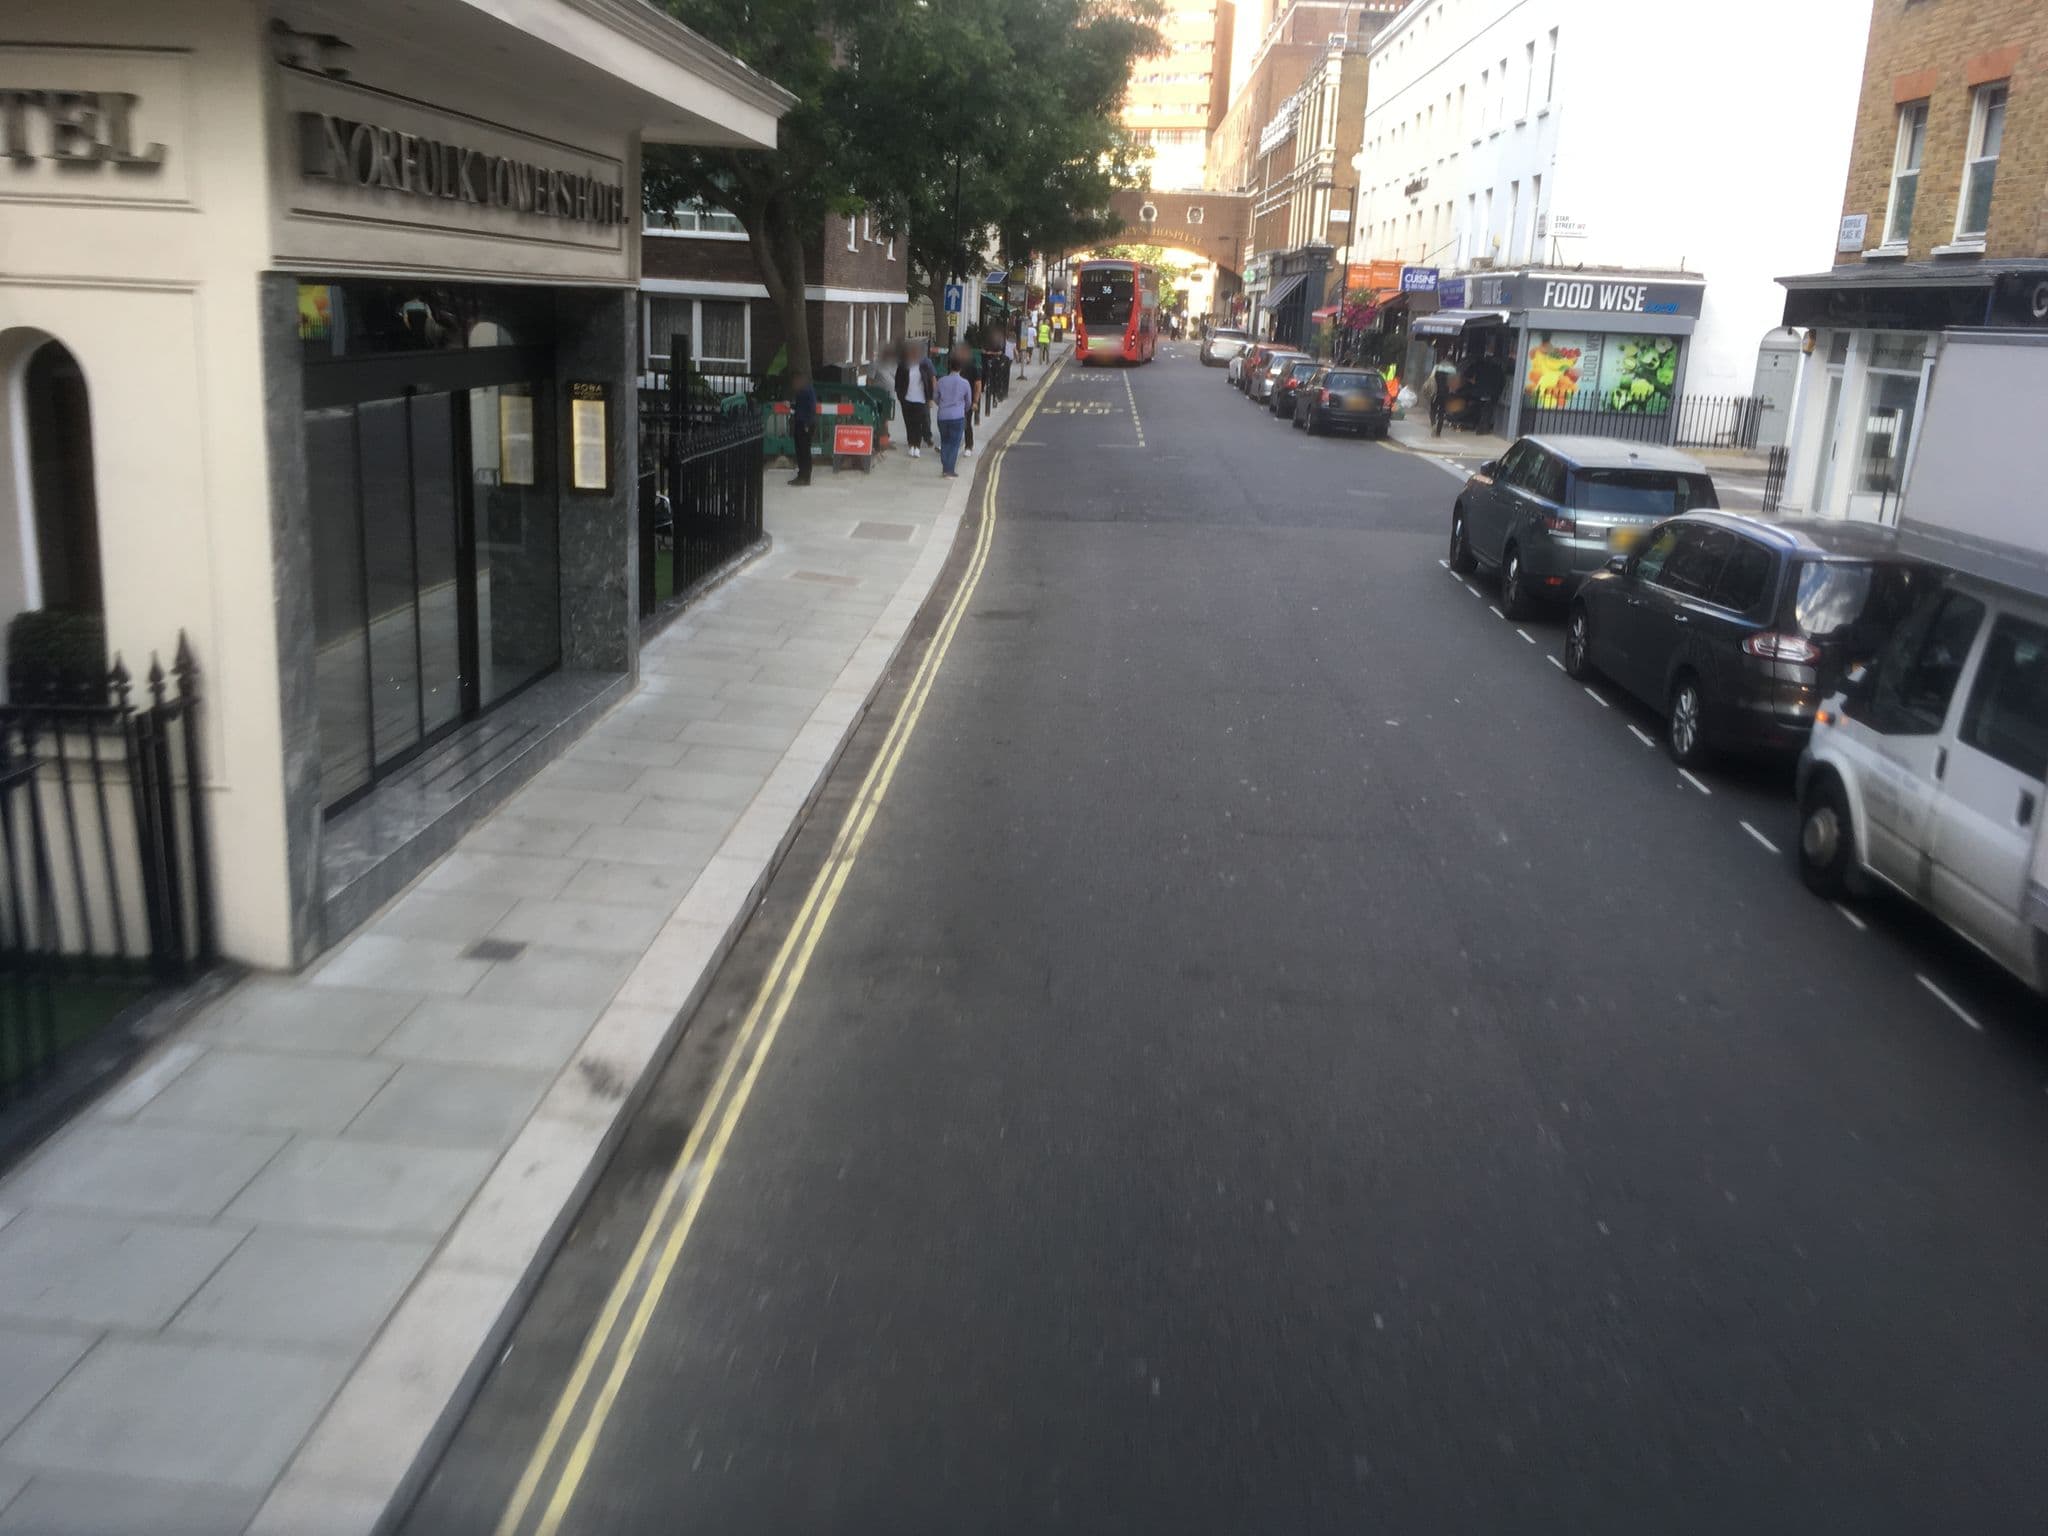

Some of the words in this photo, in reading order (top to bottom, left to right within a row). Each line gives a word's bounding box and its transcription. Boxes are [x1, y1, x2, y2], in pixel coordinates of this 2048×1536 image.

[300, 111, 486, 203] NORFOLK
[485, 154, 574, 219] TOWERS
[573, 171, 629, 225] HOTEL
[1102, 286, 1112, 294] 36
[1404, 273, 1438, 285] CUISINE
[1543, 281, 1594, 309] FOOD
[1599, 284, 1648, 313] WISE
